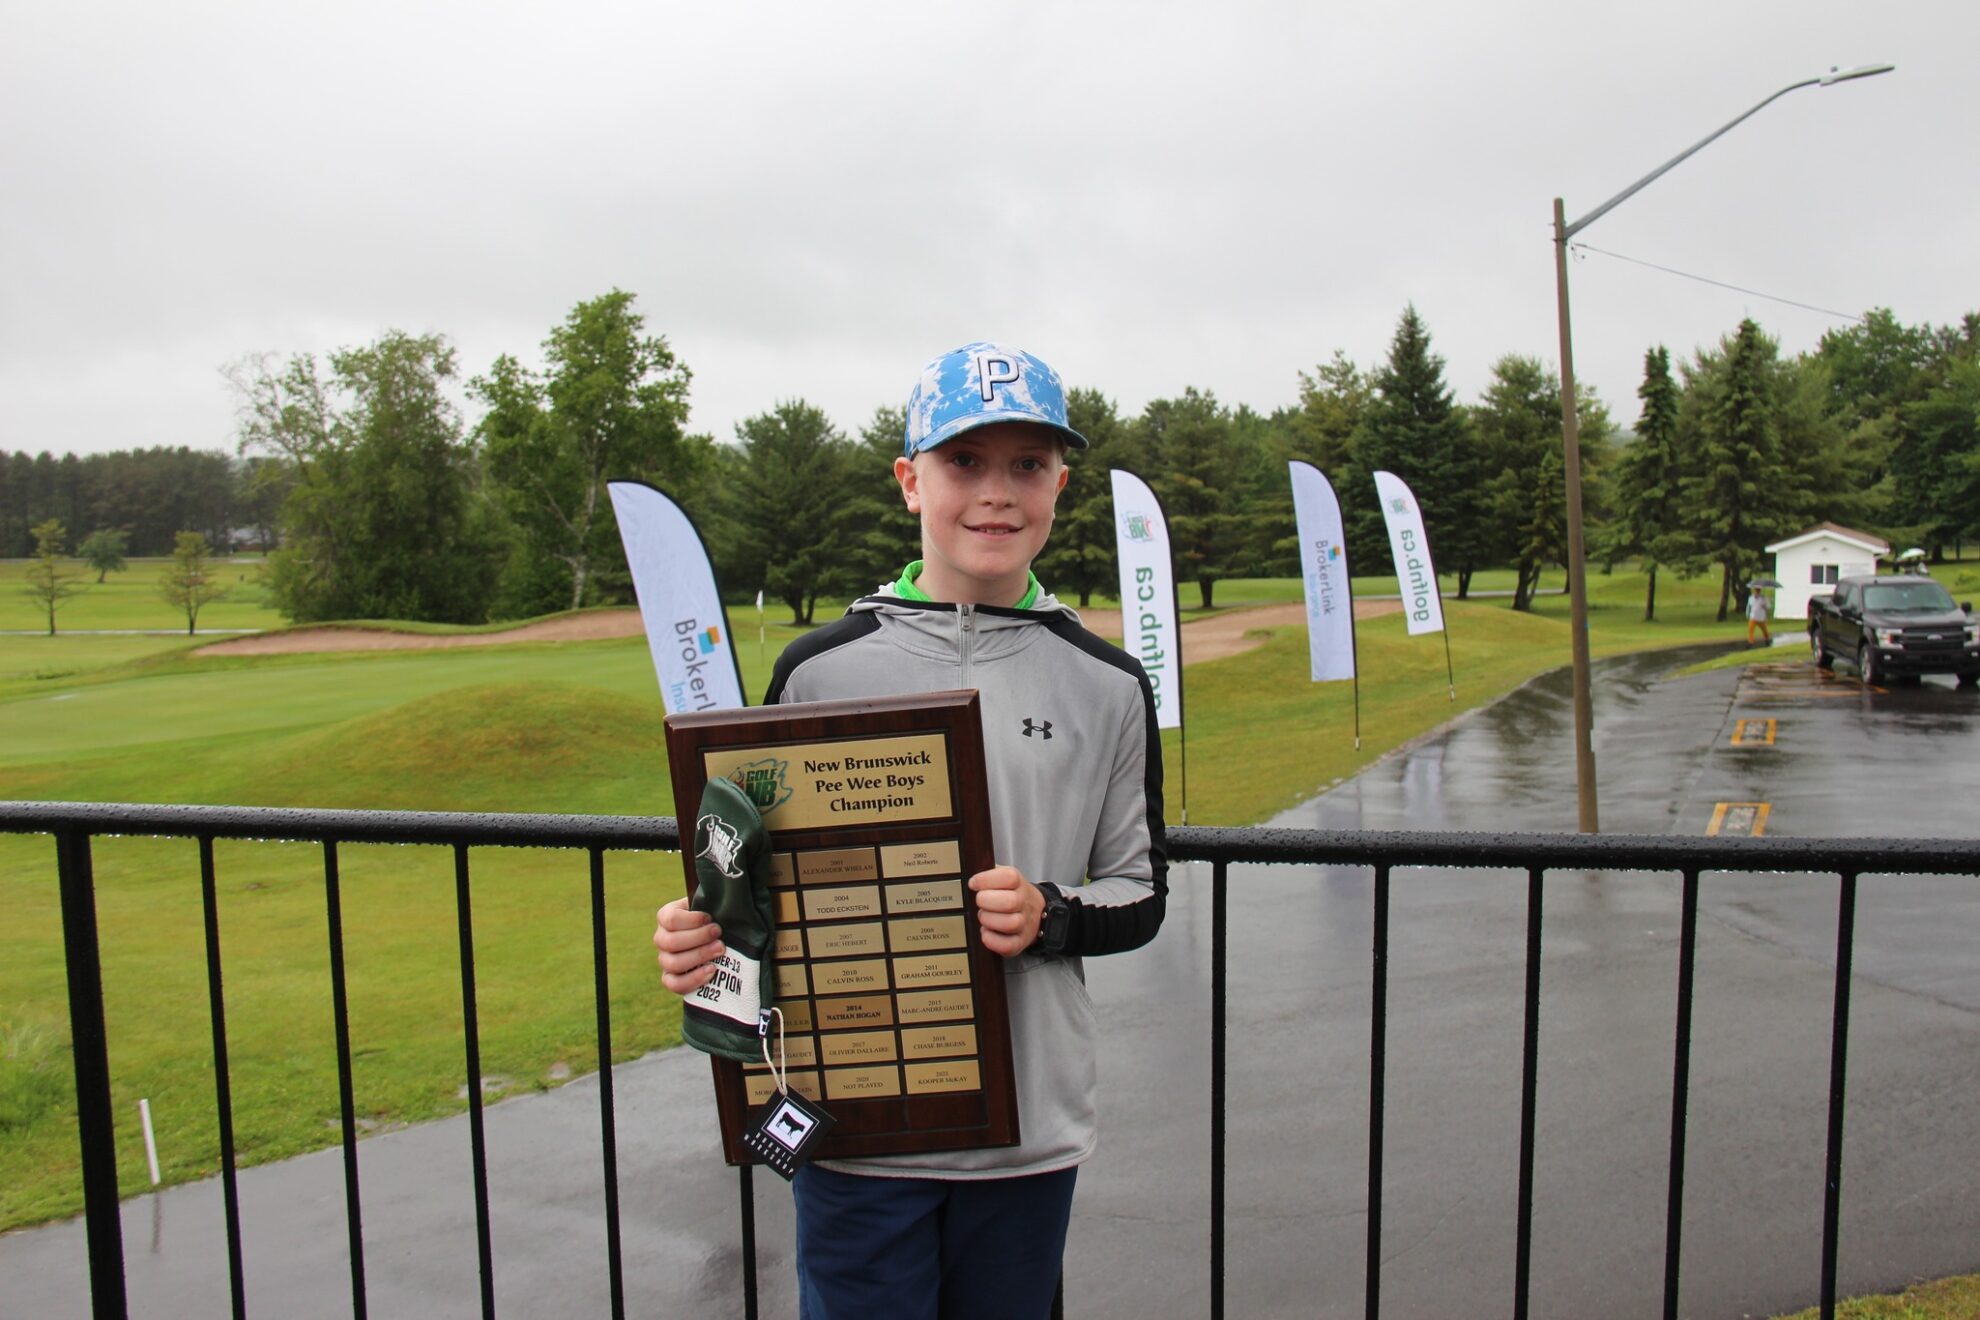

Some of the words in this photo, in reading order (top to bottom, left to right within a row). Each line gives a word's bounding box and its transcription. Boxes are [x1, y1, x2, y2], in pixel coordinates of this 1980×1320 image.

[976, 353, 1020, 402] P
[1315, 540, 1336, 615] BrokerLink
[674, 617, 718, 712] BrokerL
[804, 758, 840, 774] New
[844, 750, 932, 771] Brunswick
[746, 767, 778, 781] GOLF
[815, 777, 843, 793] Pee
[847, 775, 883, 791] Wee
[885, 773, 925, 793] Boys
[829, 794, 914, 814] Champion
[816, 906, 836, 914] TODD
[837, 904, 870, 913] ECKSTEIN
[712, 955, 741, 973] DER-13
[709, 969, 743, 996] MPION
[826, 976, 854, 985] CALVIN
[855, 975, 874, 983] ROSS
[901, 971, 931, 979] GRAHAM
[696, 985, 721, 1003] 2022
[827, 1013, 855, 1021] NATHAN
